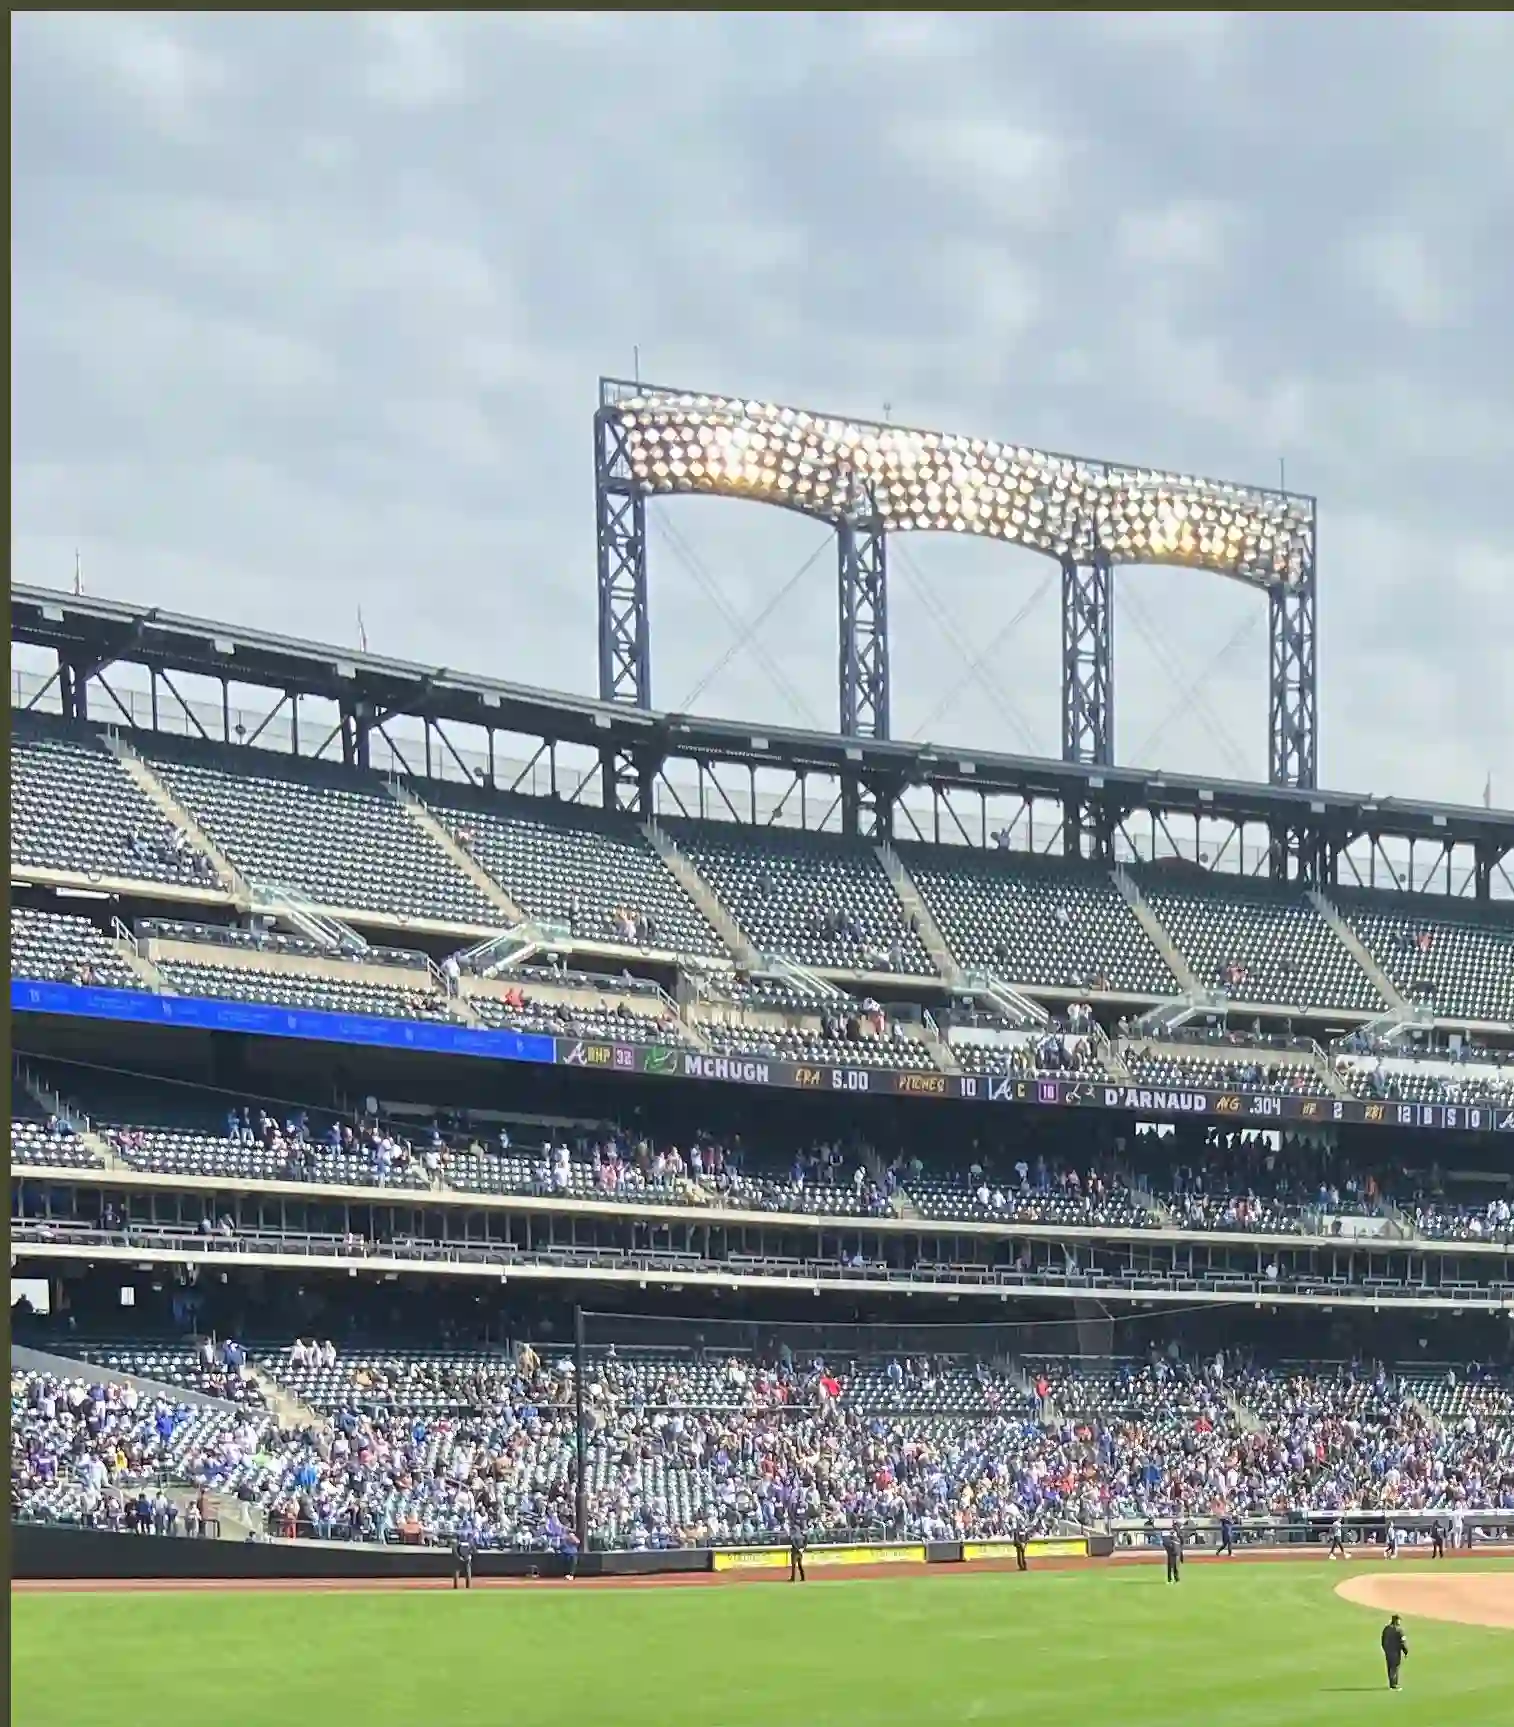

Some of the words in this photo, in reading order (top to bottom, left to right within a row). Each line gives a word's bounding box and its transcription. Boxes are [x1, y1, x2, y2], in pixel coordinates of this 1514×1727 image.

[795, 1068, 821, 1085] ERA
[832, 1069, 869, 1090] 5.00
[960, 1077, 976, 1096] 10
[1104, 1087, 1207, 1112] D'ARNAUD
[1250, 1097, 1281, 1115] .304
[1332, 1102, 1342, 1119] 2
[1397, 1104, 1411, 1123] 12
